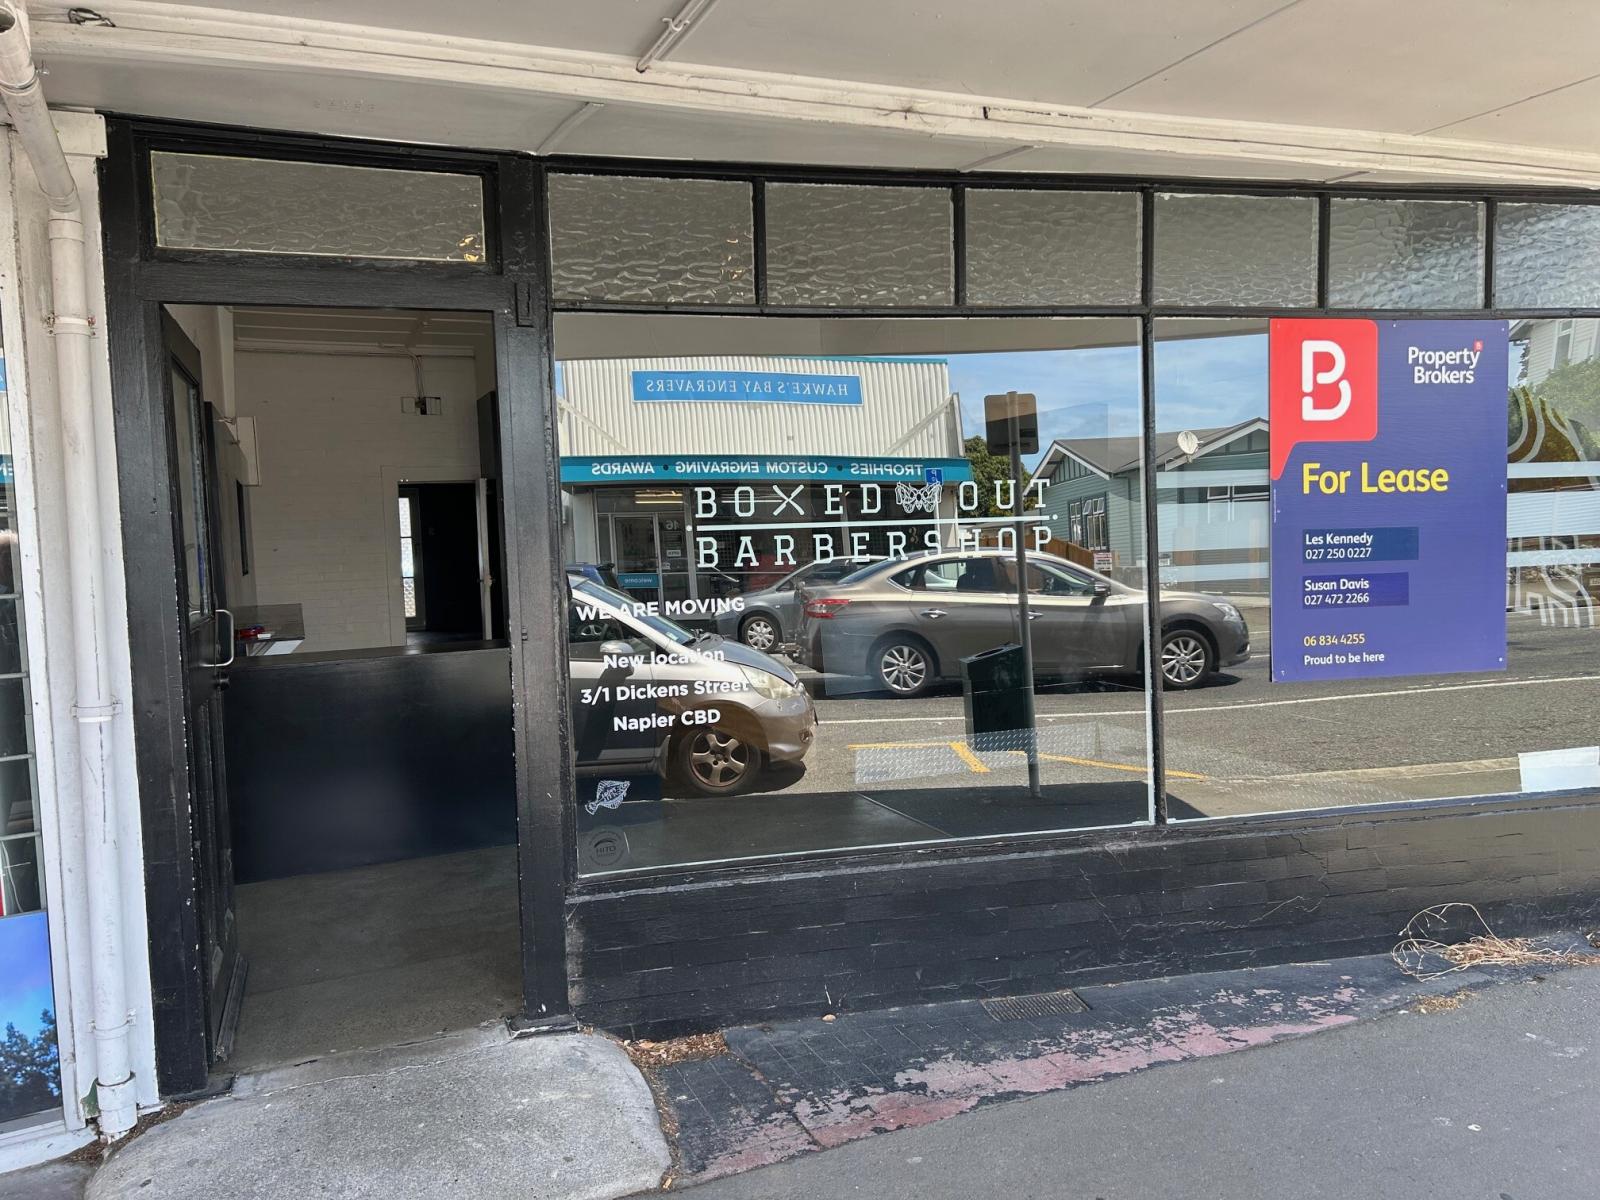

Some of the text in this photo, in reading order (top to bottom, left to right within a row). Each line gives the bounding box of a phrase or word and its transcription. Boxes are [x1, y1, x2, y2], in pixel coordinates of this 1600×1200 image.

[1408, 346, 1480, 369] Property
[1414, 366, 1474, 384] Brokers
[1303, 462, 1449, 494] For Lease
[694, 478, 1050, 518] BOXED OUT
[696, 526, 1052, 568] BARBERSHOP
[1305, 532, 1373, 546] Les Kennedy
[1305, 547, 1372, 559] 027 250 0227
[1304, 578, 1370, 591] Susan Davis
[1304, 592, 1369, 605] 027 472 2266
[576, 597, 745, 621] WE ARE MOVING
[1303, 633, 1365, 646] 06 834 4255
[603, 654, 645, 669] New
[1304, 652, 1385, 666] Proud to be here
[580, 680, 750, 705] 3/1 Dickens Street
[613, 709, 721, 732] Napier CBD
